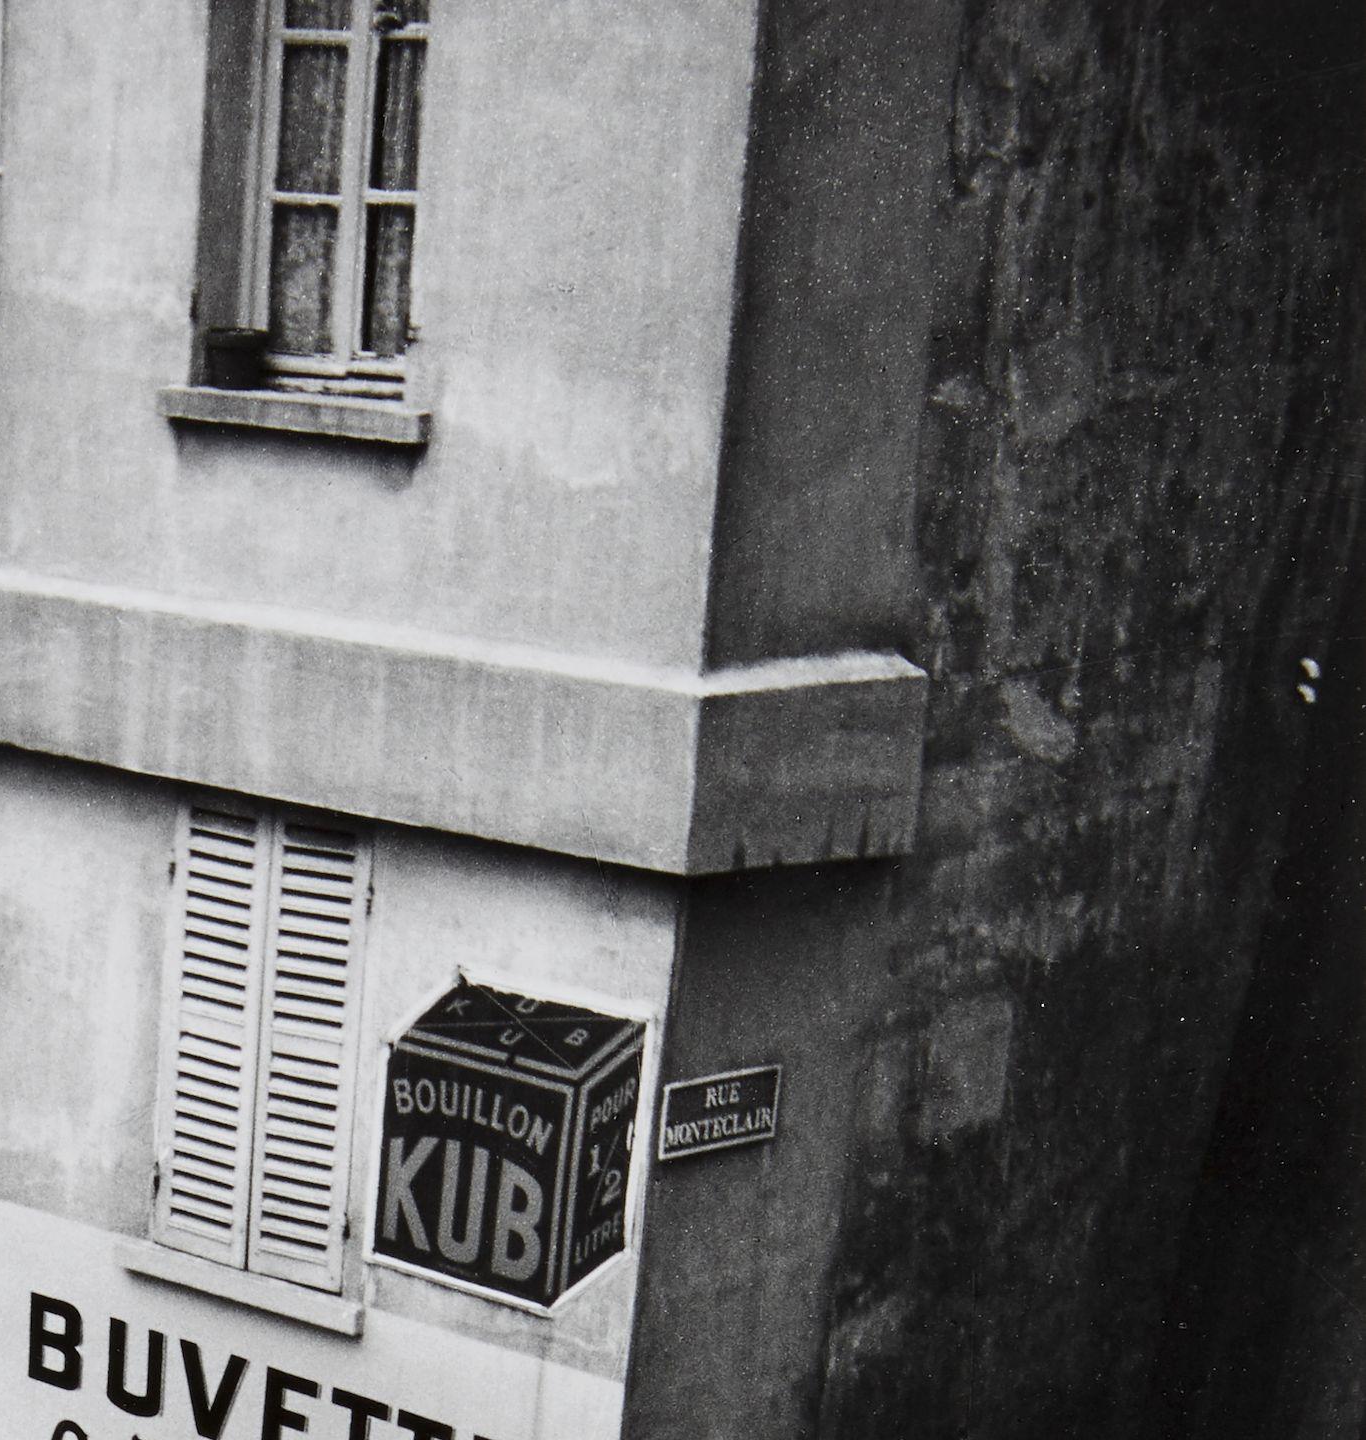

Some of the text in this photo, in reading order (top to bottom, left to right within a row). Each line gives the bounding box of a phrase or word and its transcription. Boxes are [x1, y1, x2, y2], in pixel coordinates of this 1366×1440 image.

[392, 1078, 553, 1155] BOUILLON
[591, 1077, 637, 1133] POUR
[705, 1081, 742, 1109] RUE
[383, 1136, 543, 1281] KUB
[574, 1211, 623, 1265] LITRE
